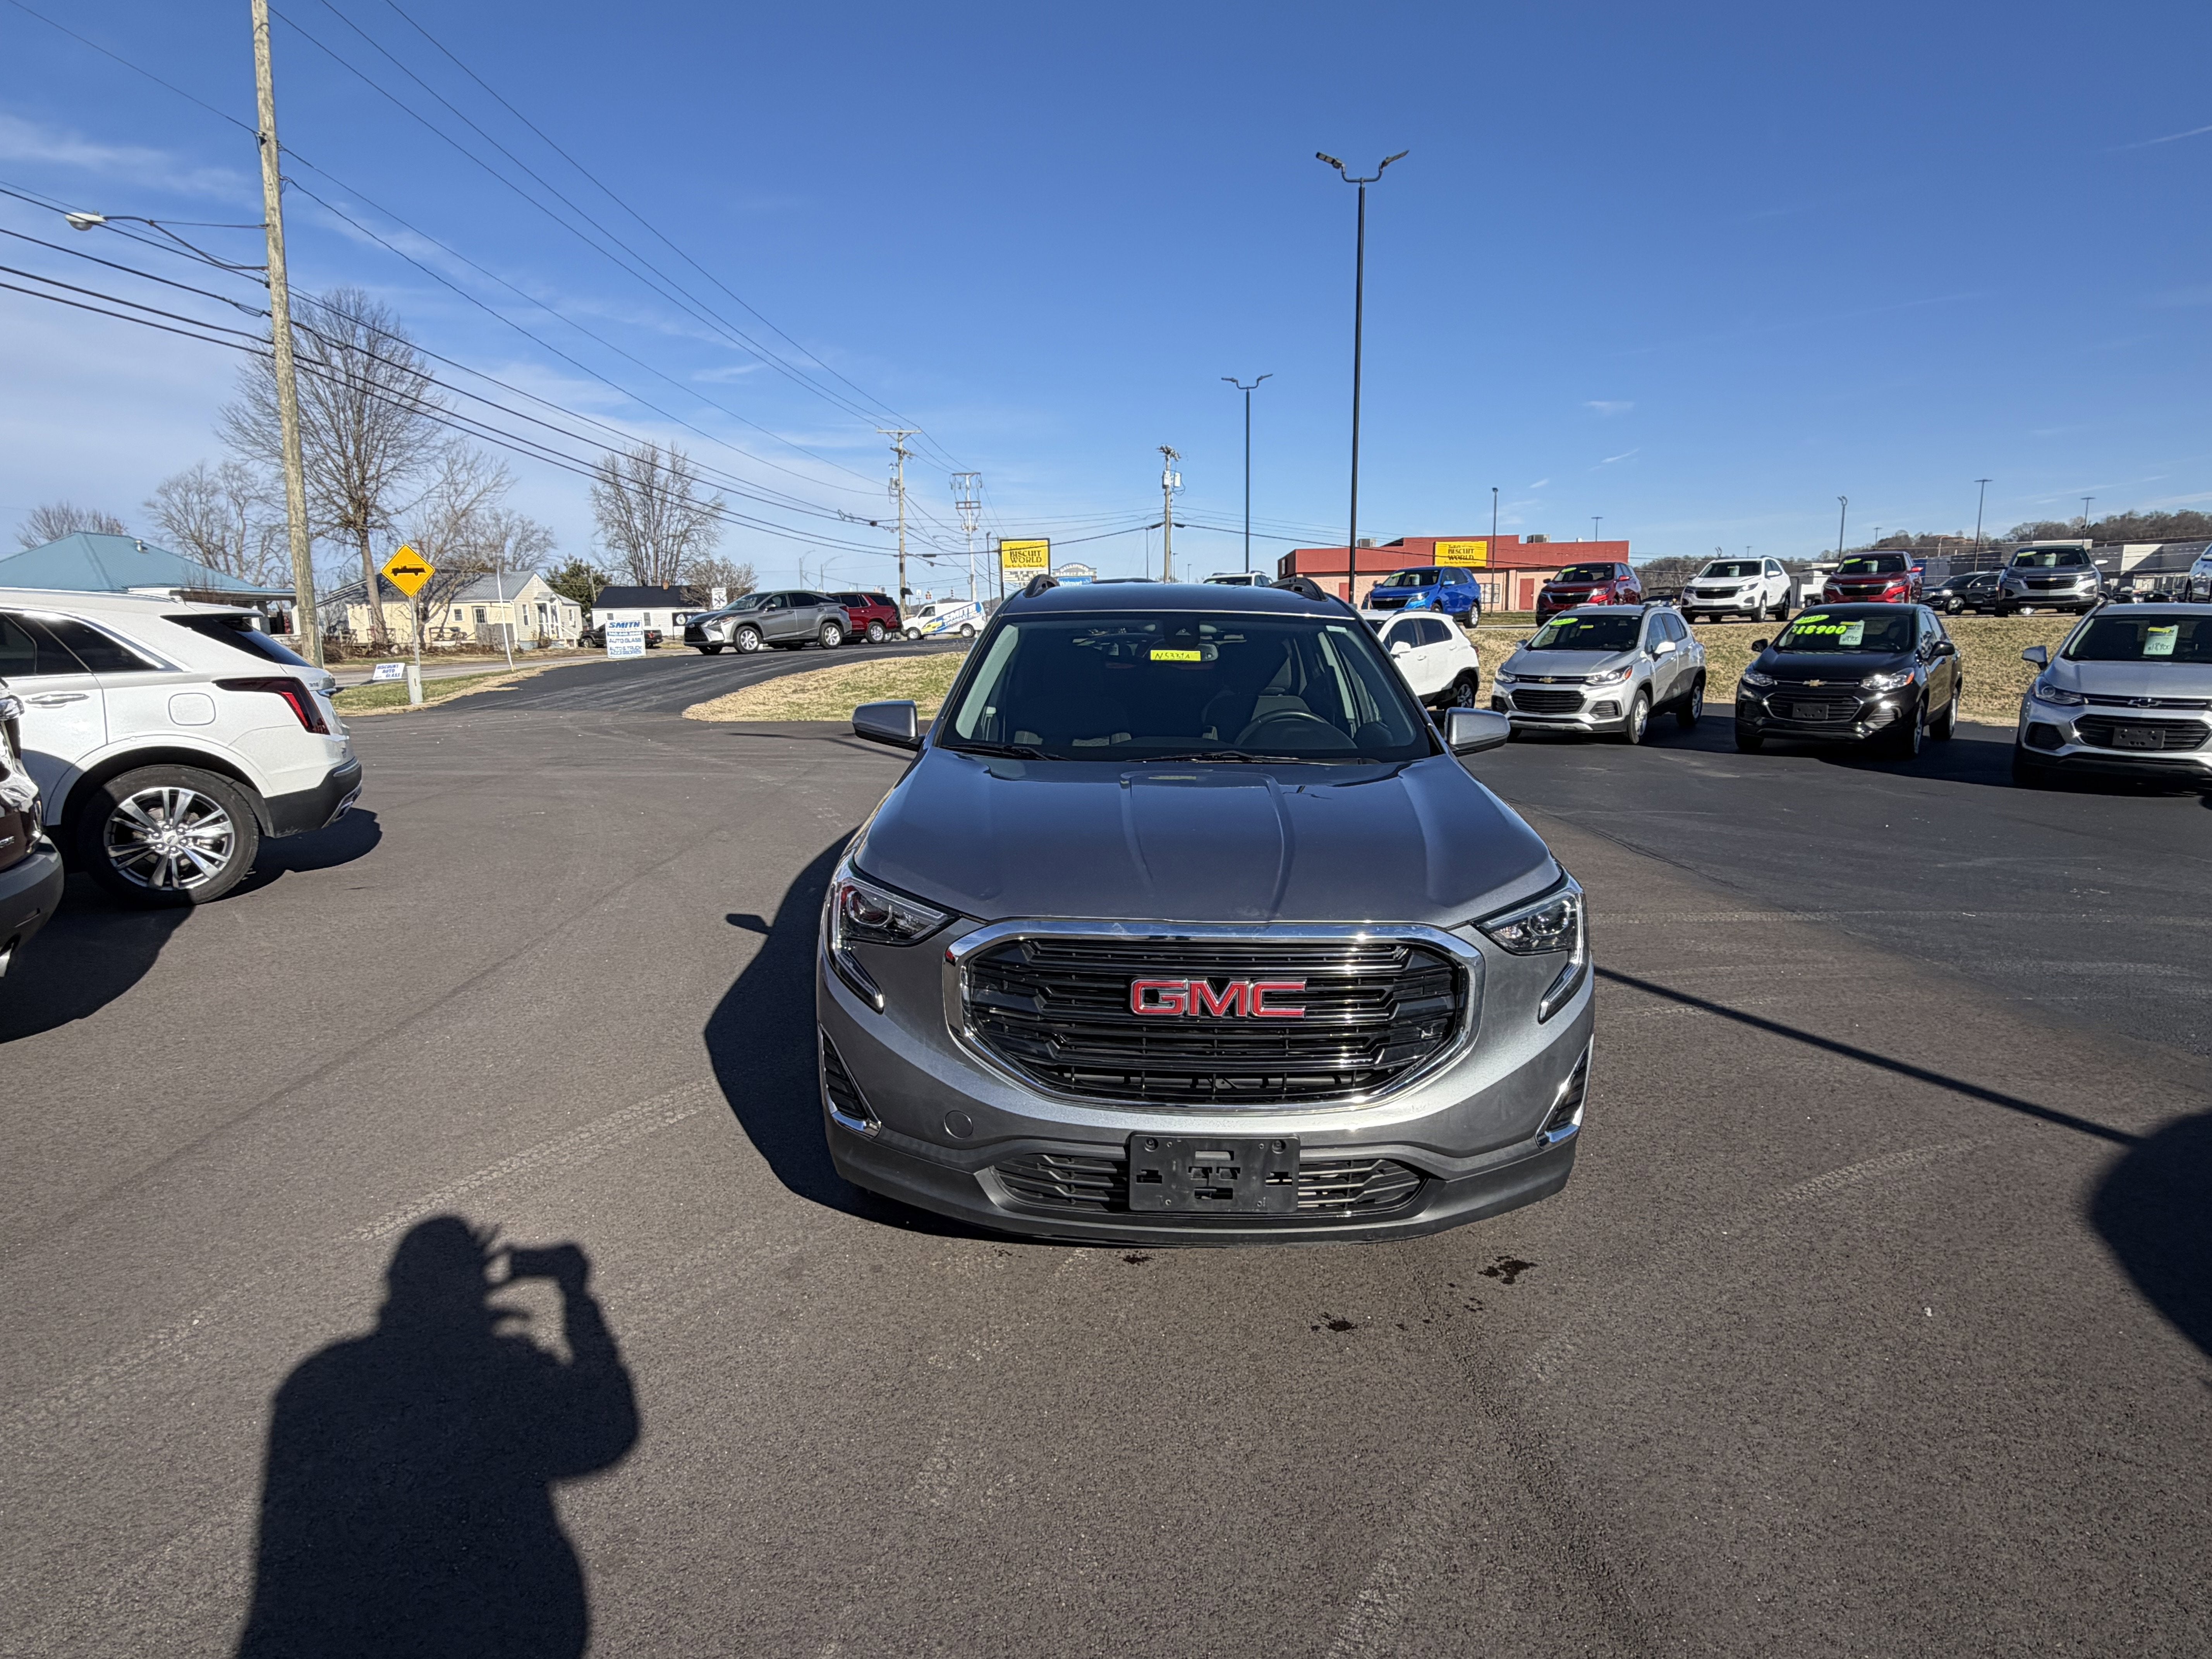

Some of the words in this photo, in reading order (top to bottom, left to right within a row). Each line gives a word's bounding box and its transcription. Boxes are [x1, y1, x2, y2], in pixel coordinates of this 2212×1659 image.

[943, 603, 976, 622] SMITH
[1792, 625, 1846, 634] $18900
[1131, 978, 1306, 1018] GMC
